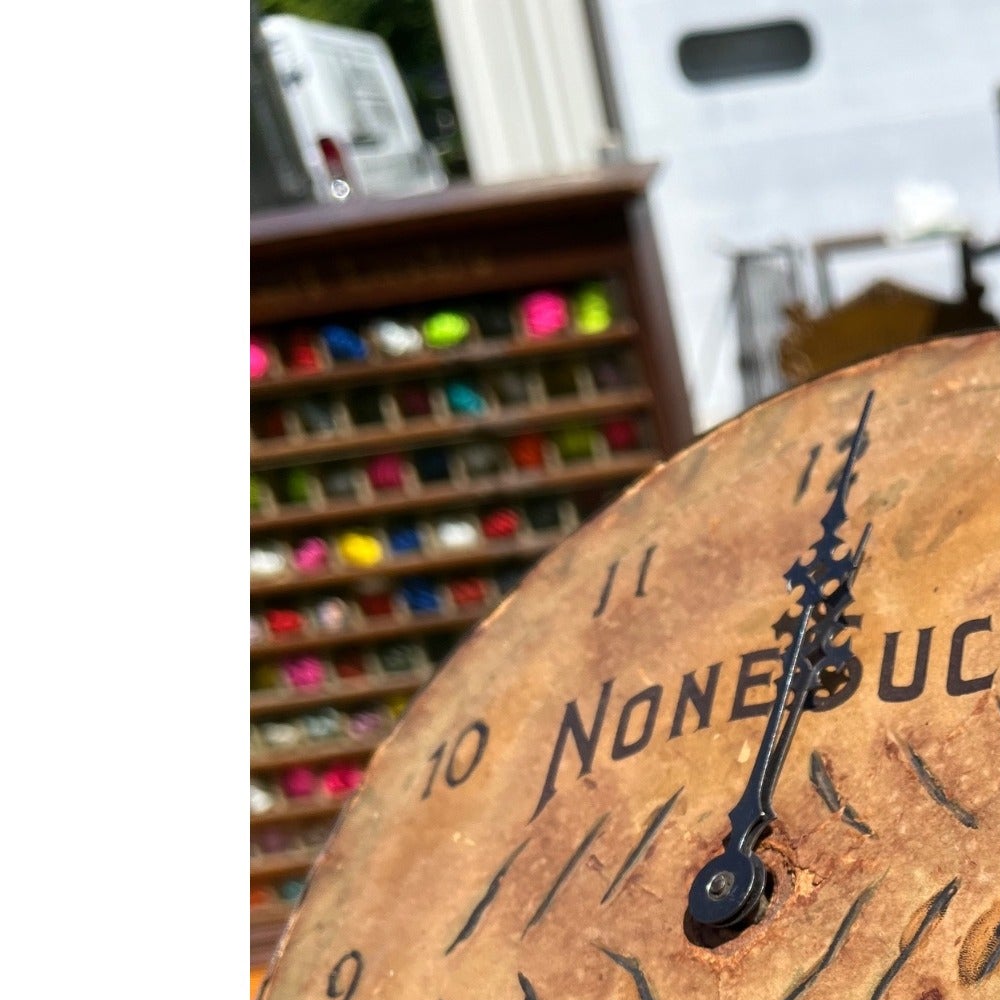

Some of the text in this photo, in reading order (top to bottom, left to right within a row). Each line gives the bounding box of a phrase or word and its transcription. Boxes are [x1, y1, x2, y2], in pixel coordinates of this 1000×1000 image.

[794, 430, 870, 505] 12
[593, 545, 656, 617] 11
[422, 720, 489, 801] 10
